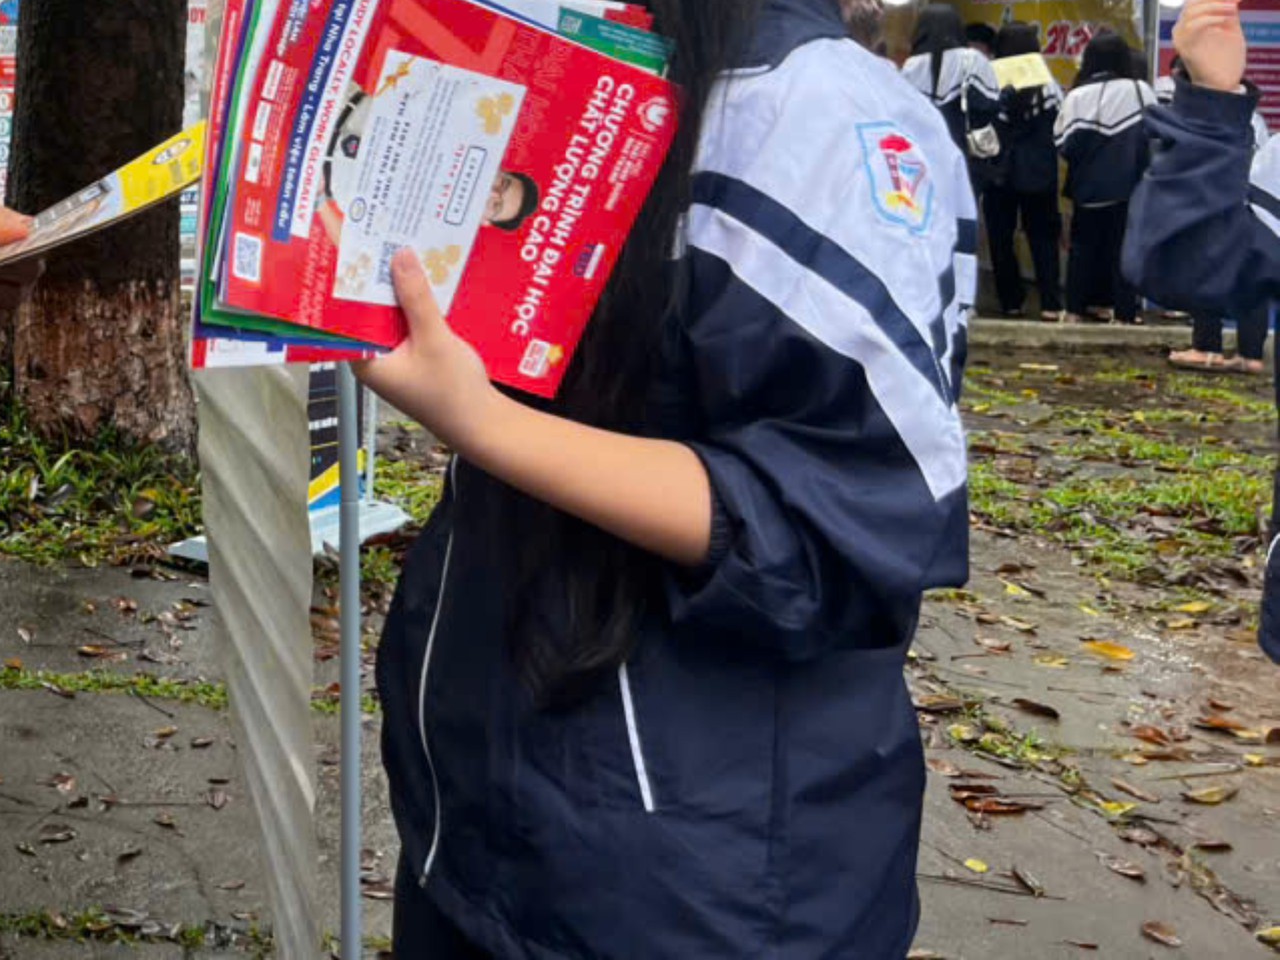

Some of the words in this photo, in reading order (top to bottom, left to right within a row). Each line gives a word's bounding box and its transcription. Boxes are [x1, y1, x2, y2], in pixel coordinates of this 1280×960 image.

[320, 22, 340, 53] Nha
[306, 54, 329, 93] Trang
[313, 98, 338, 144] WORK
[576, 73, 617, 134] CHẤT
[578, 81, 635, 181] CHƯƠNG
[293, 146, 323, 222] GLOBALLY
[539, 133, 589, 214] LƯỢNG
[517, 214, 551, 263] CAO
[548, 182, 591, 247] TRÌNH
[526, 246, 560, 286] ĐẠI
[505, 285, 544, 337] HỌC
